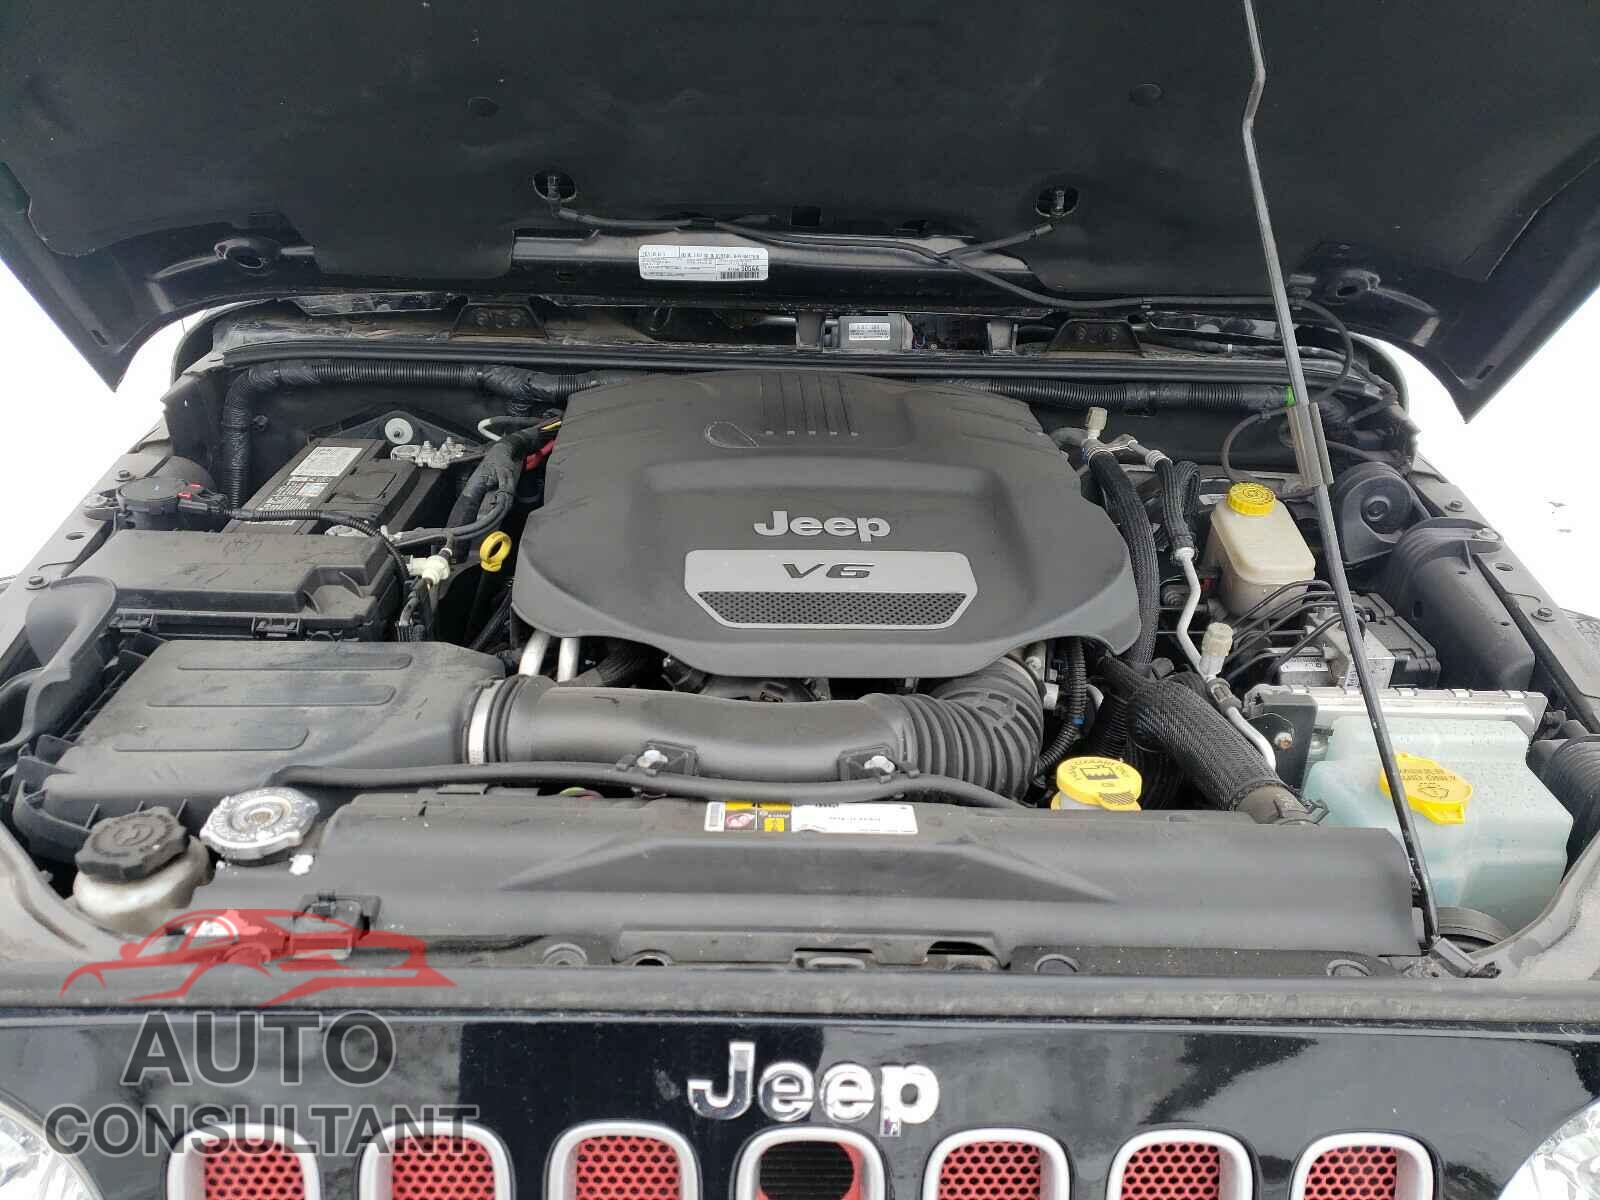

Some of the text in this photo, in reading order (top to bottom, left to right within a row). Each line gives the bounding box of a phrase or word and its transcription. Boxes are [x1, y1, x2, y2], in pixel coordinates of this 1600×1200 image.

[753, 510, 891, 542] Jeep
[783, 562, 876, 579] V6
[687, 1041, 940, 1137] Jeep
